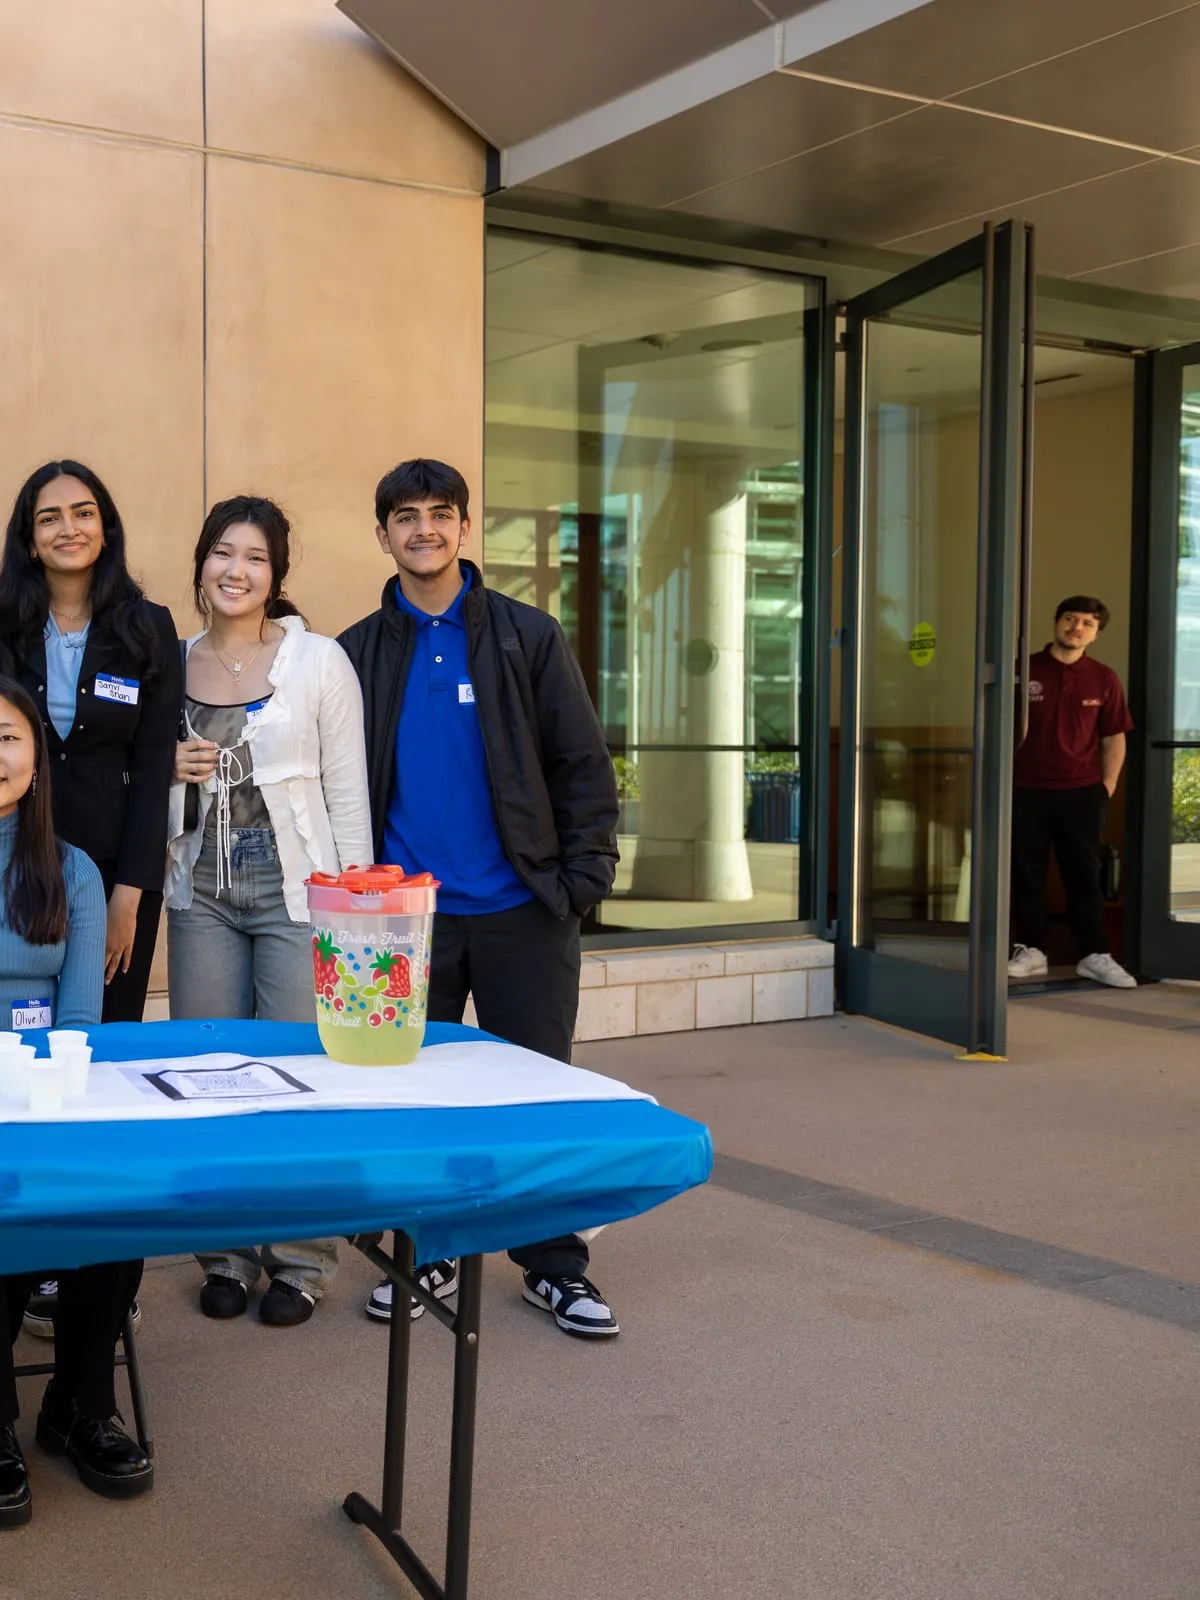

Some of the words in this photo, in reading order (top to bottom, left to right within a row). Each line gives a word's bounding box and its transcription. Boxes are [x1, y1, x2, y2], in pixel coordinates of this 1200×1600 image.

[338, 930, 377, 944] Fresh
[381, 931, 414, 945] Fruit
[15, 1011, 36, 1027] Olive
